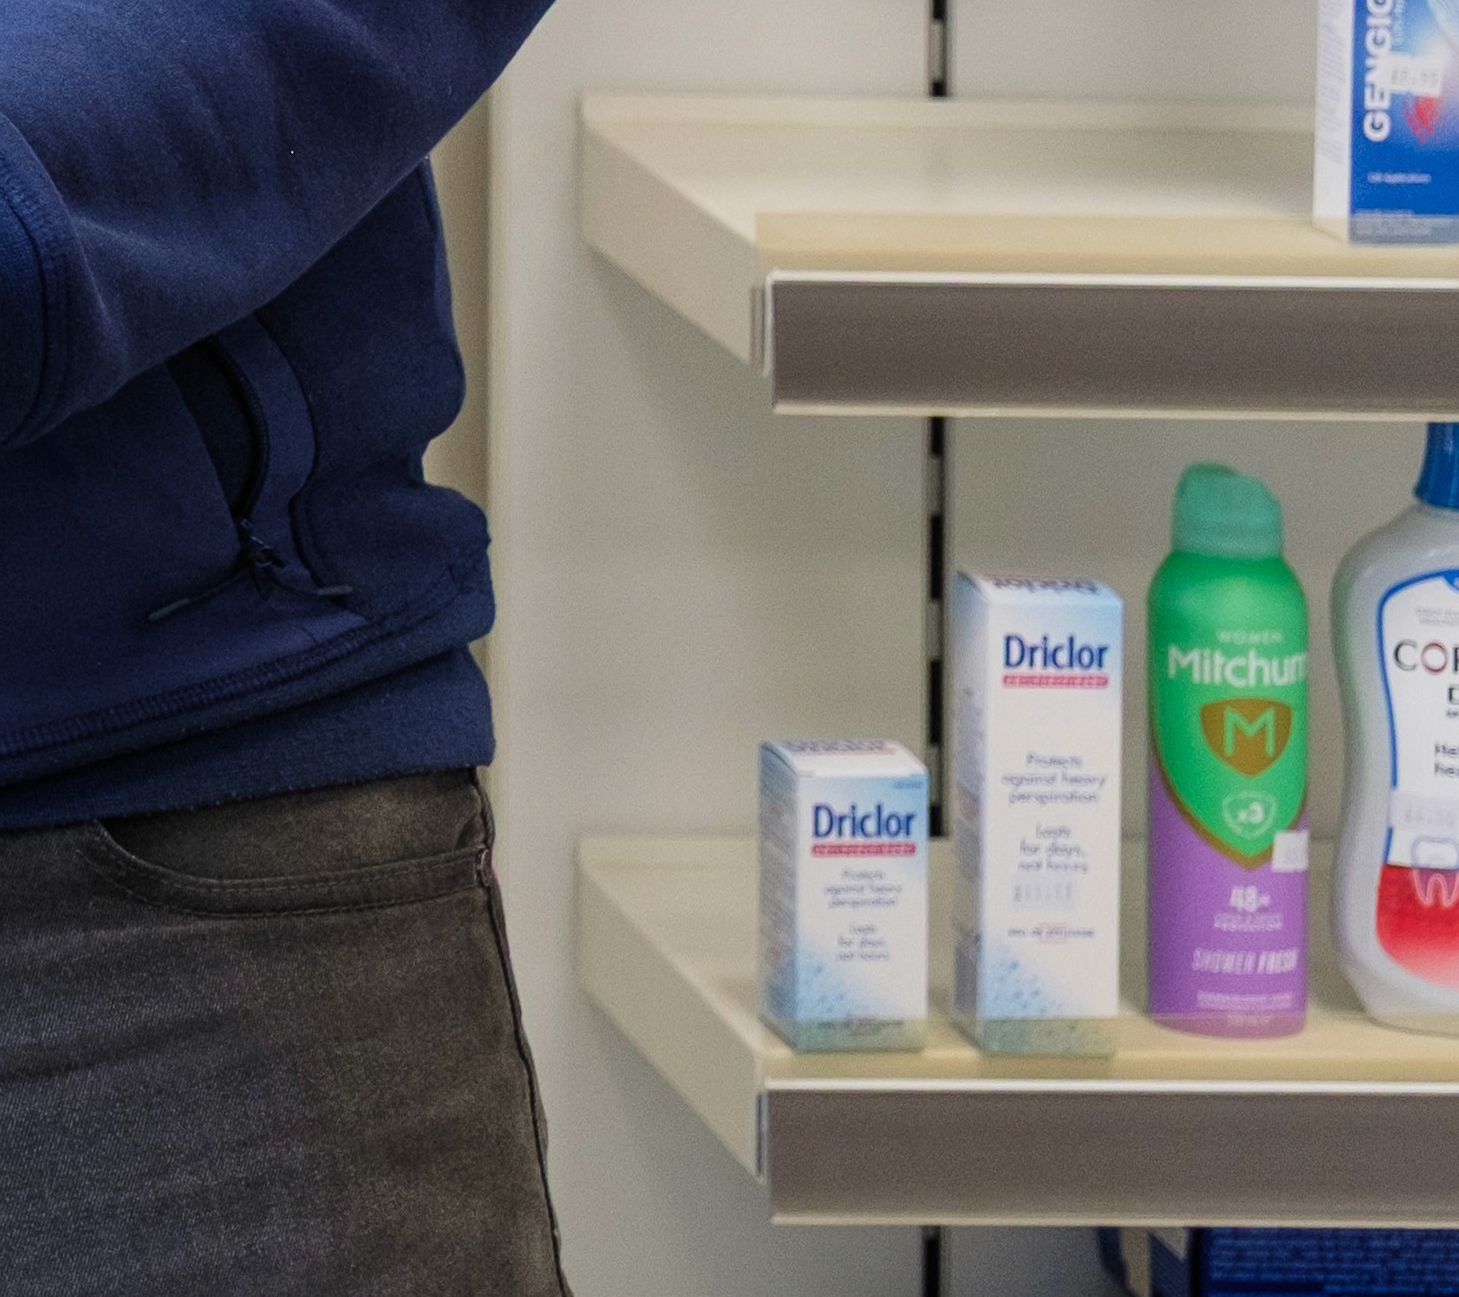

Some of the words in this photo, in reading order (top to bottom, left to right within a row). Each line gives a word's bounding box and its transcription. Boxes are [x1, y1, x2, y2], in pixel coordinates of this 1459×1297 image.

[1003, 633, 1111, 670] Driclor
[1224, 706, 1277, 757] M
[811, 802, 917, 839] Driclor
